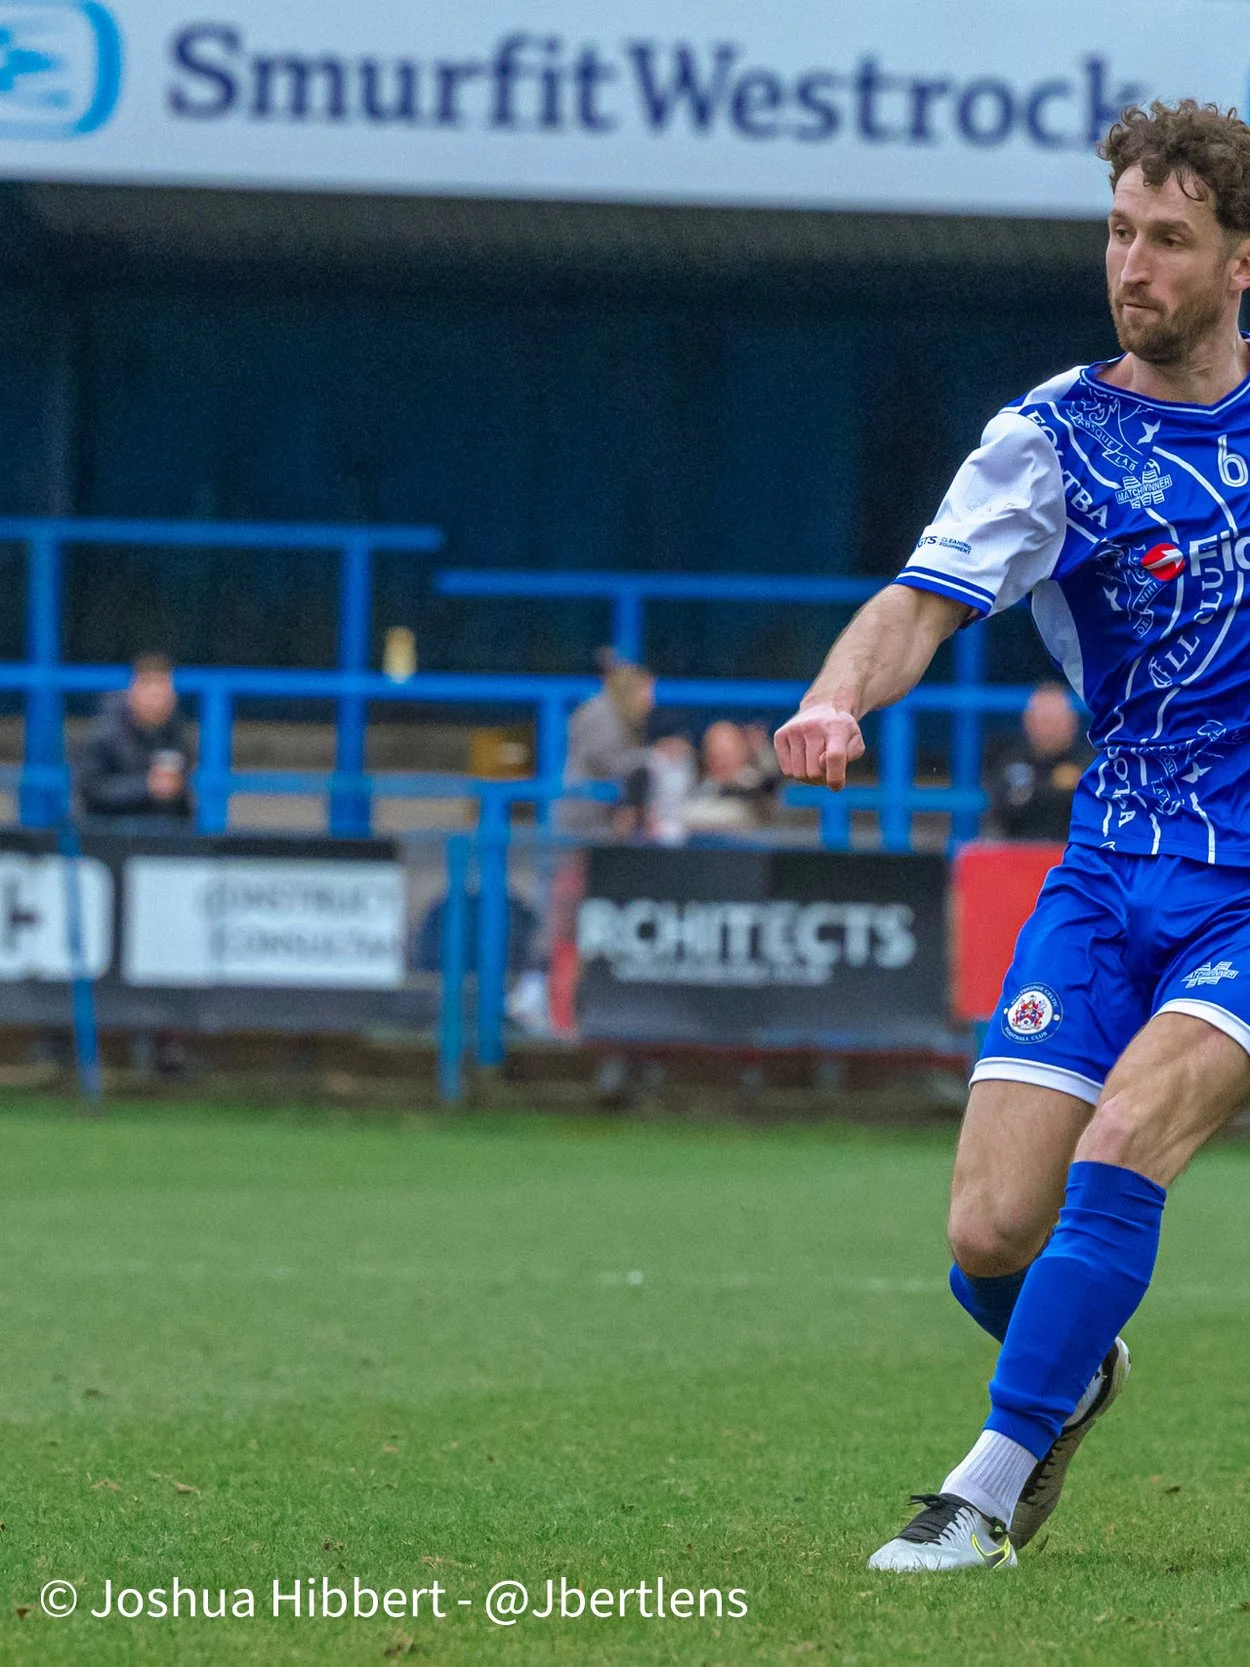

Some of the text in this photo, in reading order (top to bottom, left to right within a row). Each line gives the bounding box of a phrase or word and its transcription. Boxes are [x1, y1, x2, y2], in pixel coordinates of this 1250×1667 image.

[166, 23, 1146, 150] SmurfitWestrock
[1217, 434, 1248, 487] 6
[1117, 477, 1170, 502] MATCHWINNER
